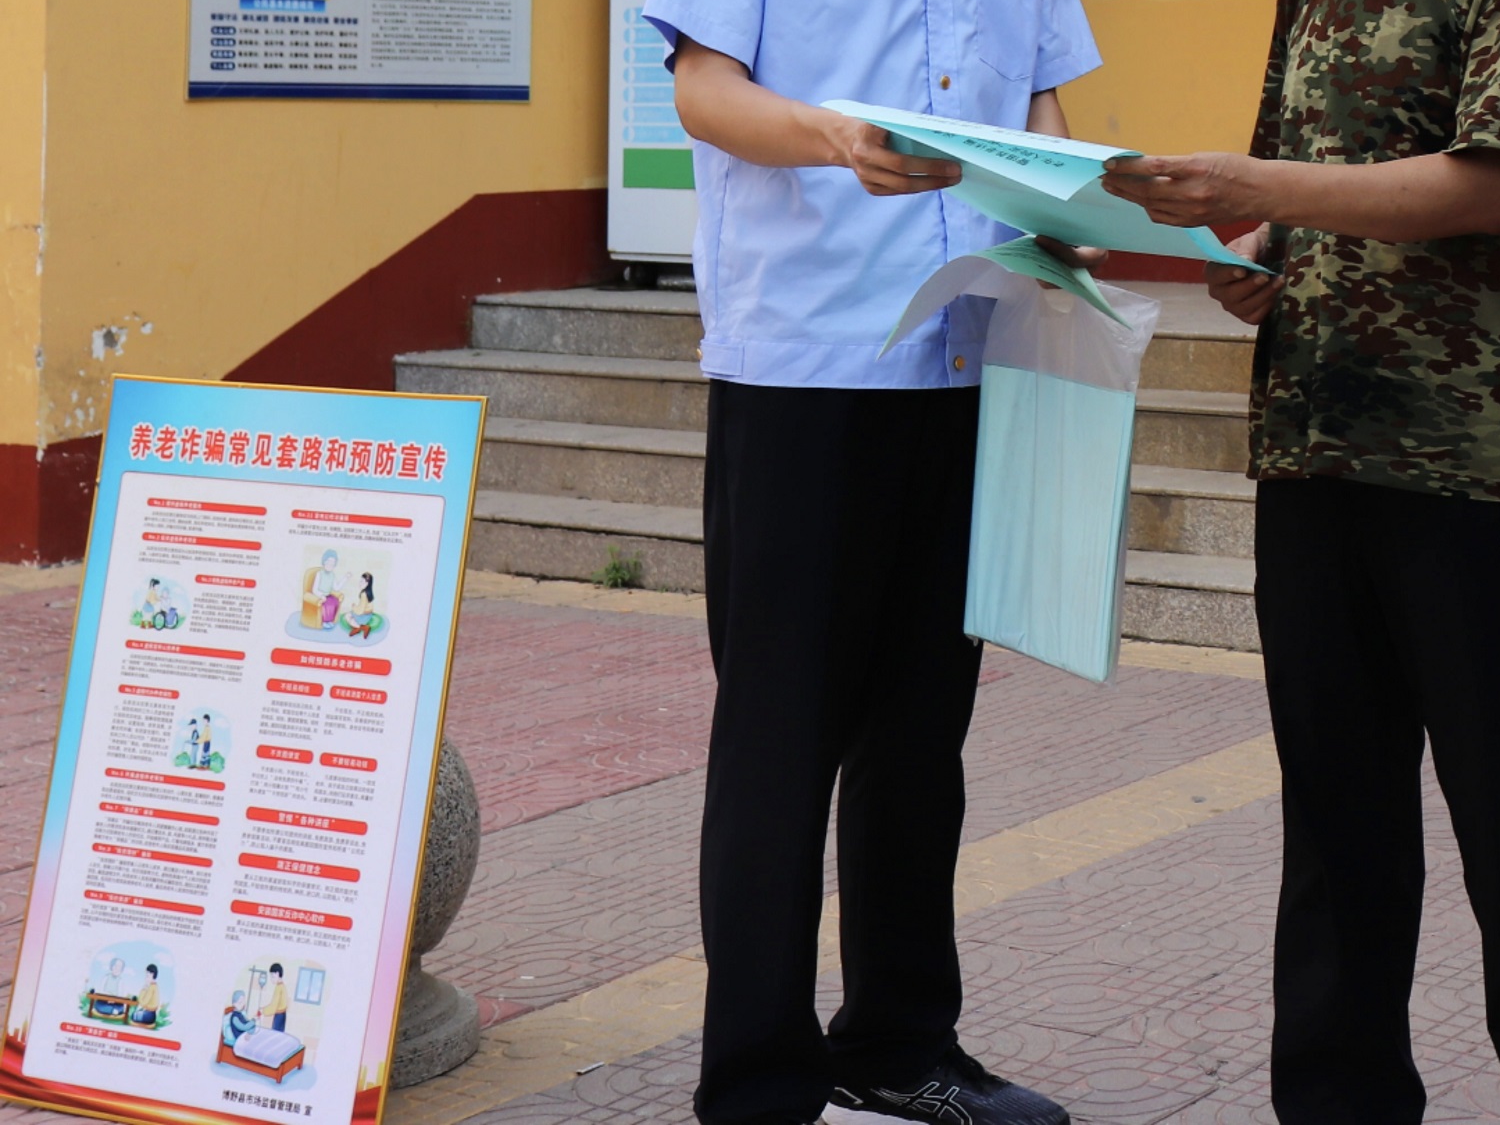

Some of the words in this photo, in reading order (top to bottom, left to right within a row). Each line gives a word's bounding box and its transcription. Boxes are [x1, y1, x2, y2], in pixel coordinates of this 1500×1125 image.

[129, 422, 448, 483] 养老诈骗常见套路和预防宣传
[222, 1090, 301, 1114] 博野县市场监督管理局
[304, 1106, 313, 1116] 宣
